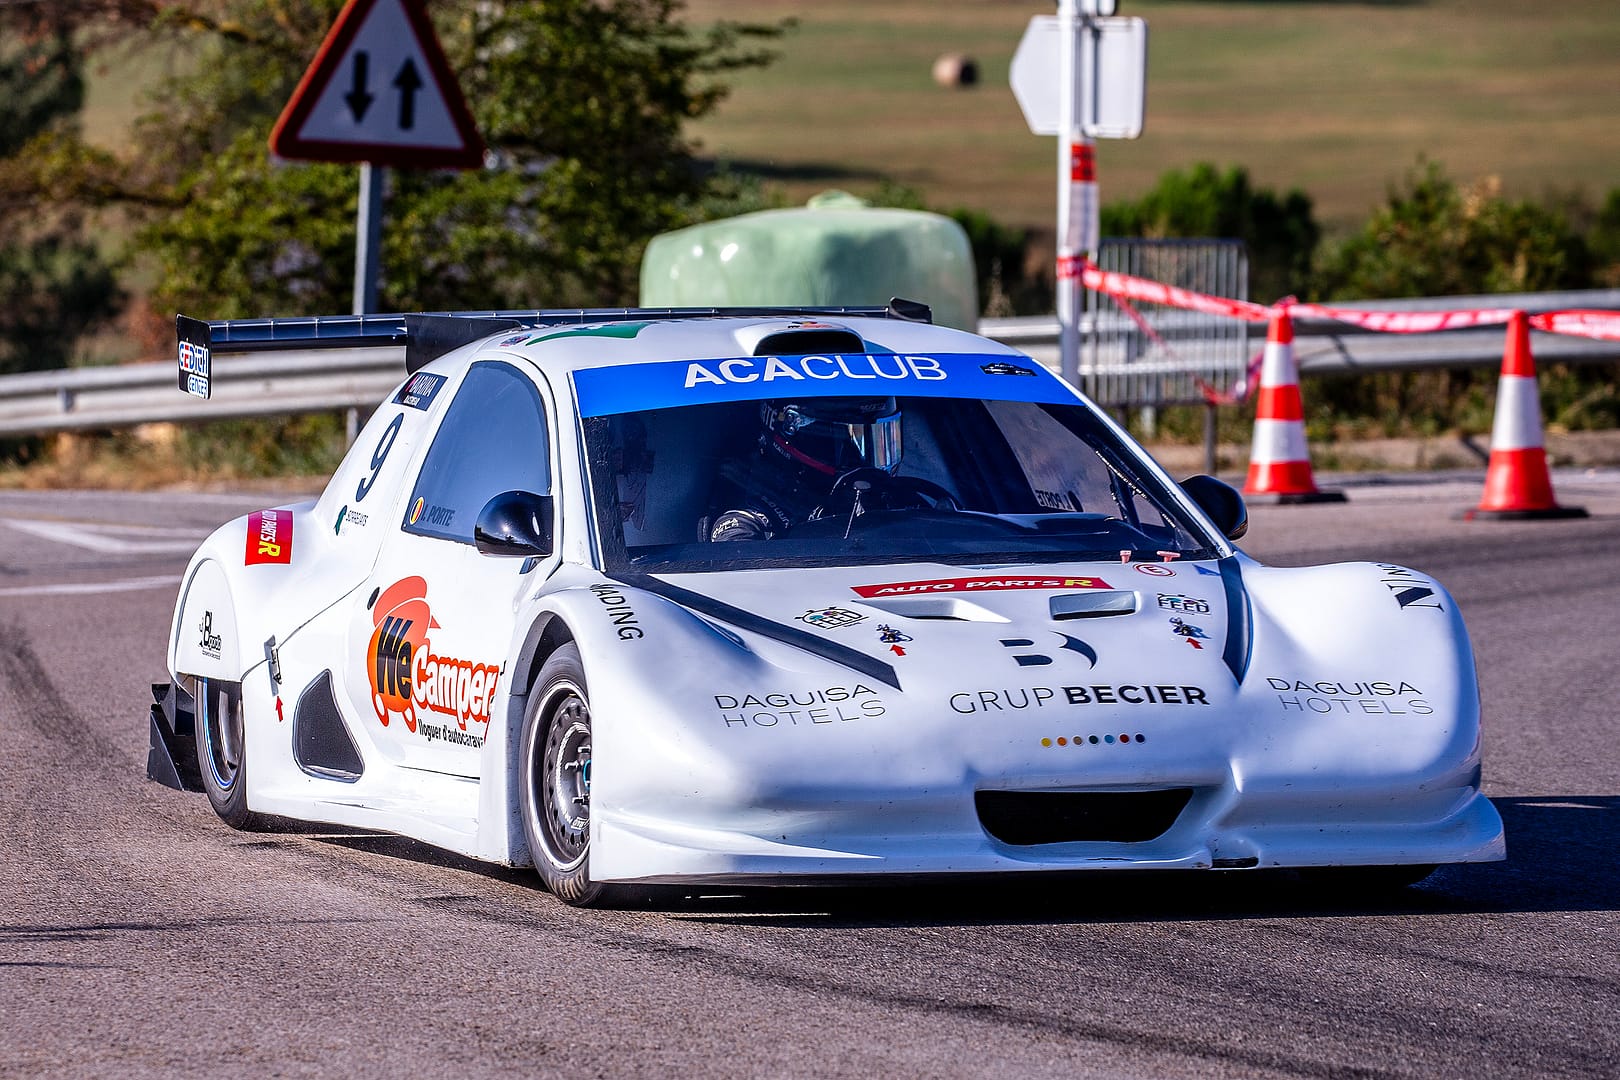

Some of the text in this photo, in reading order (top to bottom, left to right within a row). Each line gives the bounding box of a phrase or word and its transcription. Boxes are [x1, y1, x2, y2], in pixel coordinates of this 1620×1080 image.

[684, 355, 947, 388] ACACLUB
[355, 412, 405, 503] 9
[428, 506, 456, 527] PORTE
[874, 583, 955, 594] AUTO
[1157, 596, 1210, 613] FEED
[808, 610, 863, 629] FEED
[714, 684, 878, 710] DAGUISA
[1266, 677, 1423, 696] DAGUISA
[949, 685, 1211, 714] GRUP BECIER
[1277, 694, 1434, 715] HOTELS
[722, 699, 886, 728] HOTELS
